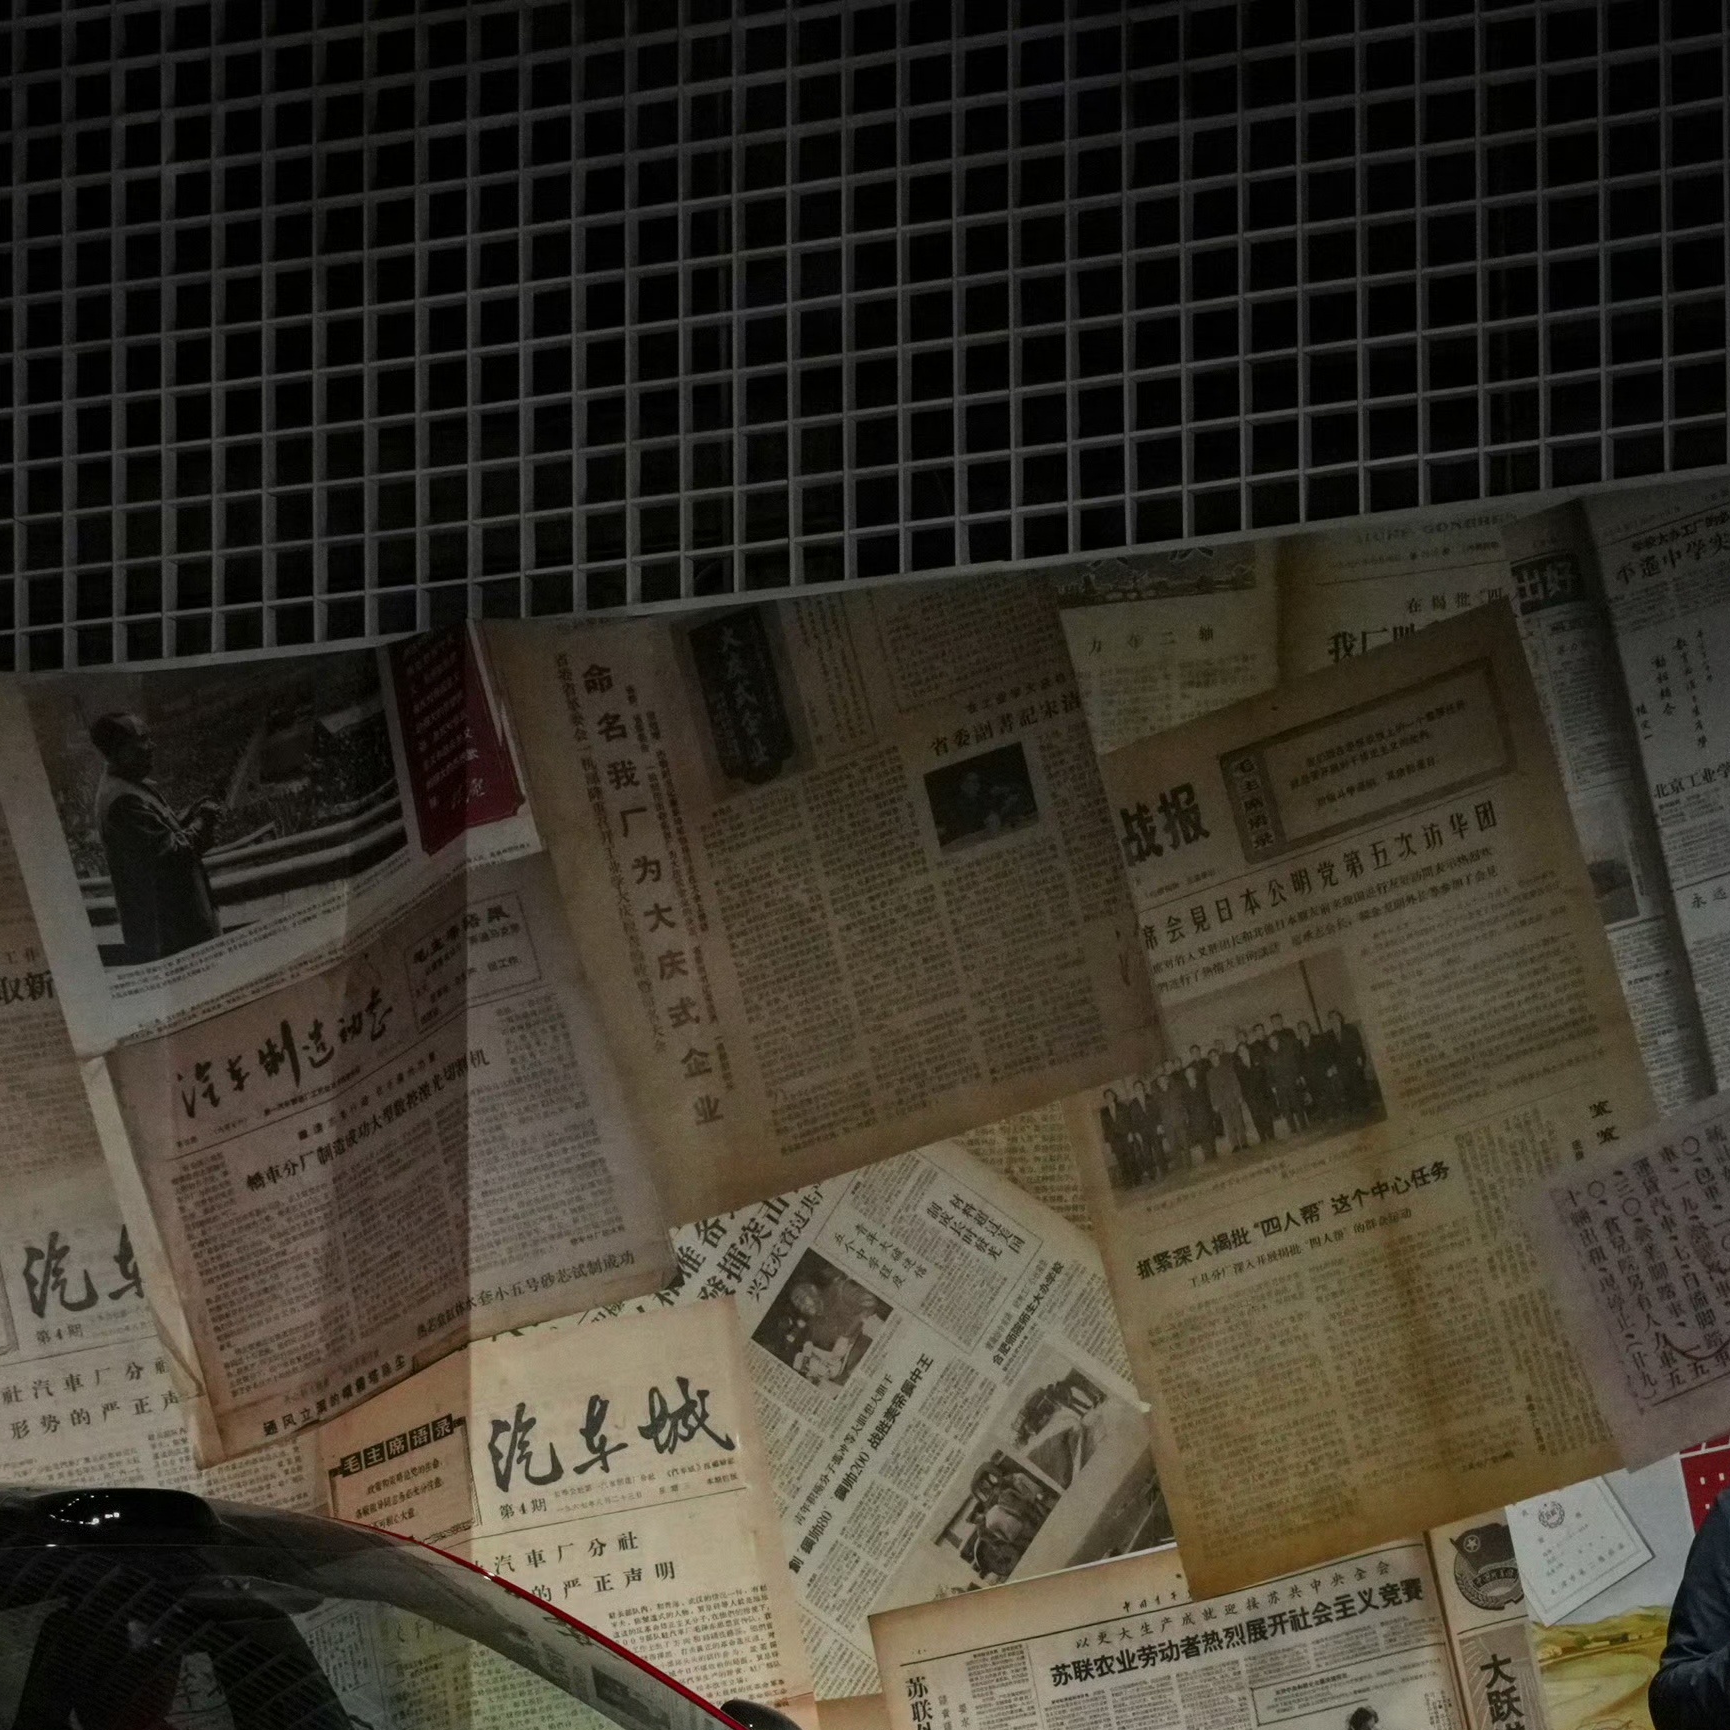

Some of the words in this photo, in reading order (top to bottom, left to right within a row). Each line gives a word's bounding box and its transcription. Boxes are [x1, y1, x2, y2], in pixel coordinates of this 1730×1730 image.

[1119, 782, 1212, 869] 战报
[582, 663, 725, 1126] 命名我厂为大庆式企业
[340, 1413, 455, 1478] 毛主席语录
[487, 1376, 736, 1493] 汽车城
[499, 1498, 548, 1519] 第4期
